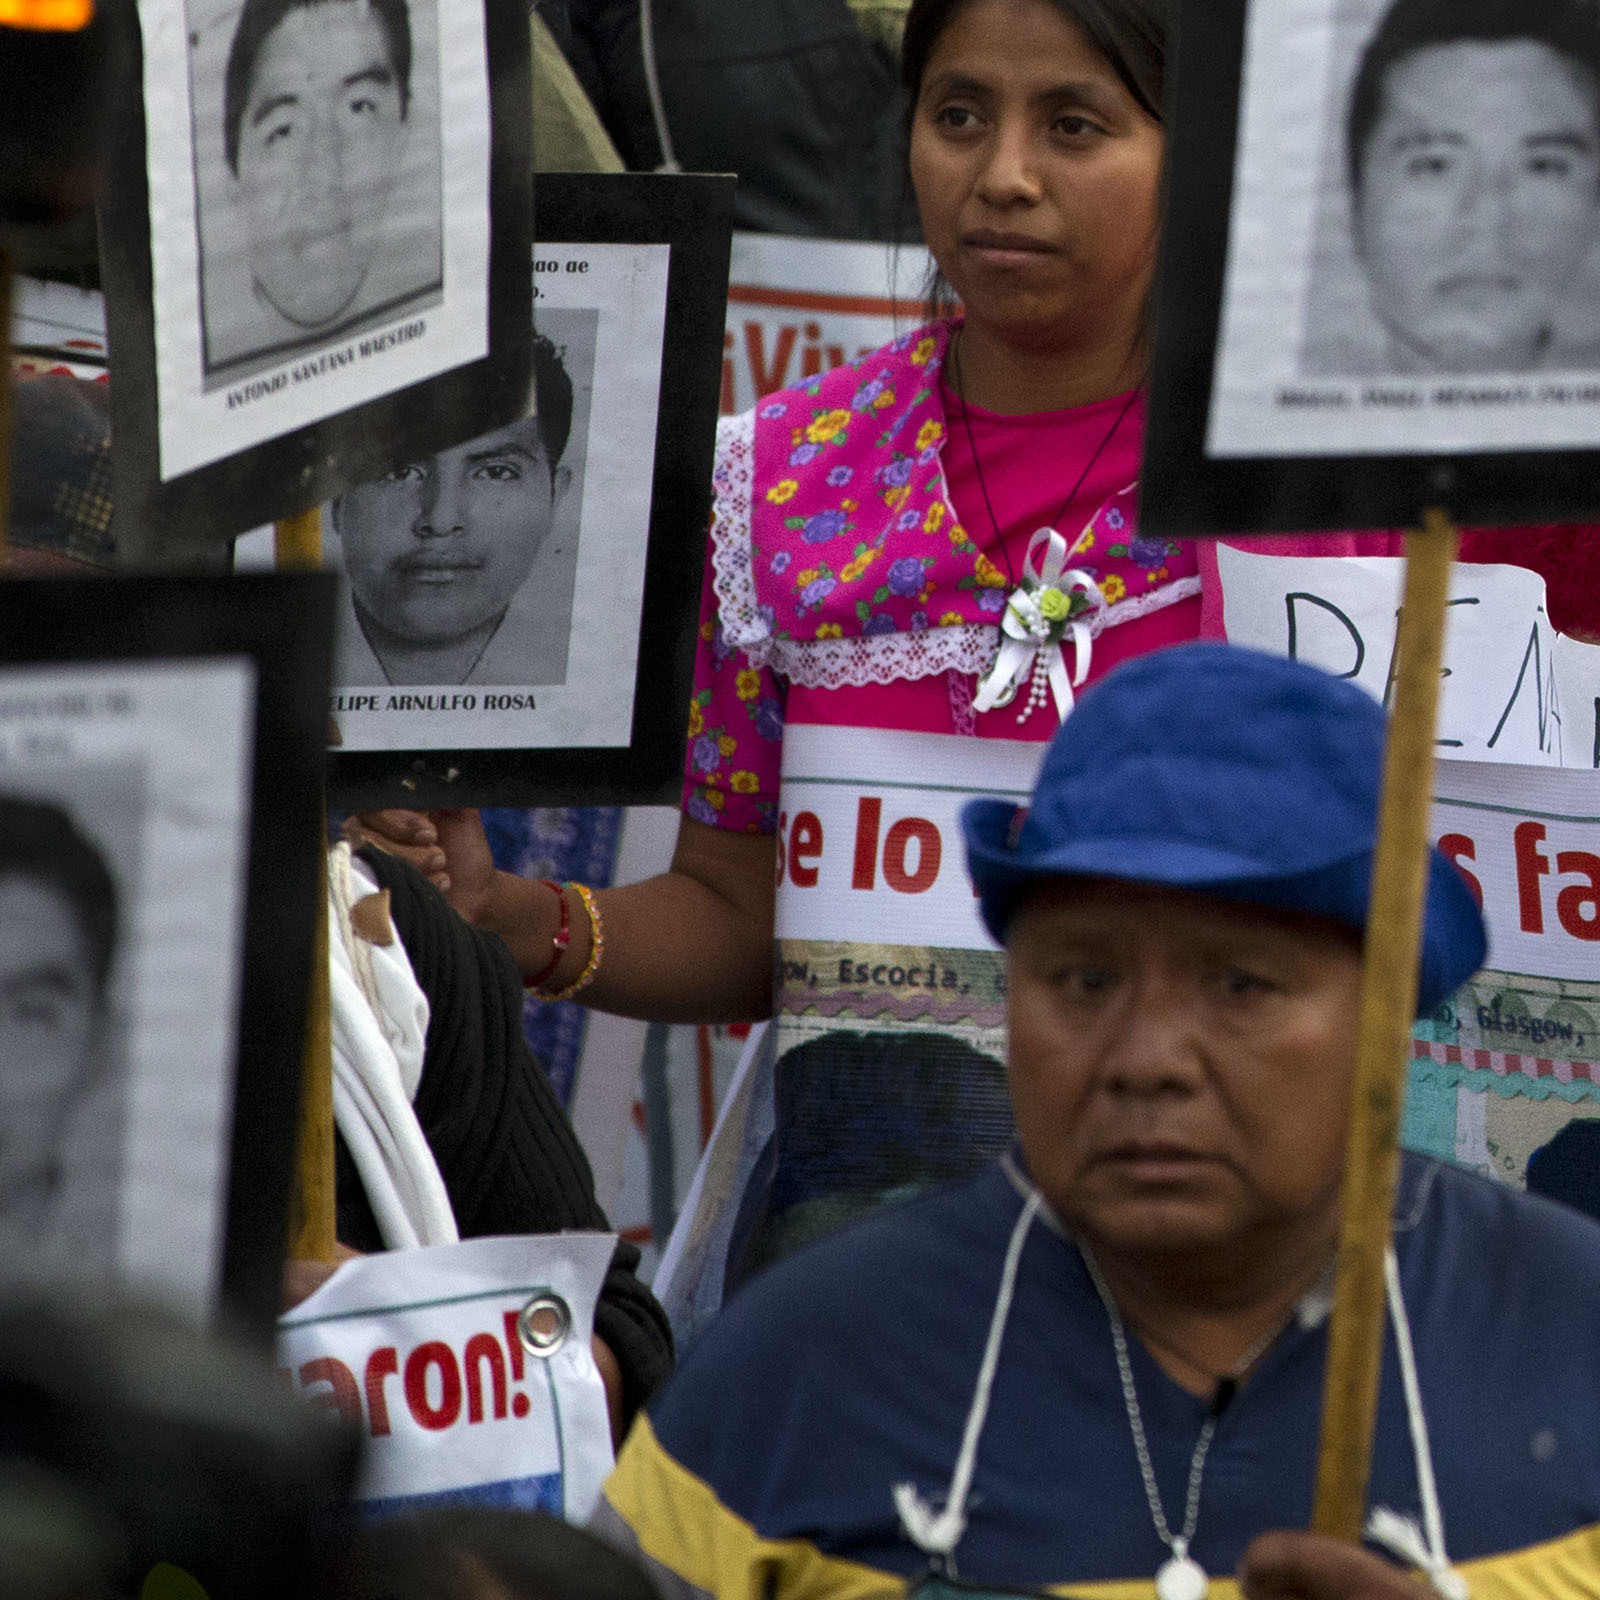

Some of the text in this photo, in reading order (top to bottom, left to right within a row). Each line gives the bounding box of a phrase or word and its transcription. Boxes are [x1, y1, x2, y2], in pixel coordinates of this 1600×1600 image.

[226, 317, 427, 410] ANTONIO SANTANA MAESTRO
[385, 694, 477, 712] ARNULFO
[483, 694, 537, 712] ROSA
[838, 958, 971, 995] Escocia,
[1477, 1006, 1585, 1049] Glasgow,
